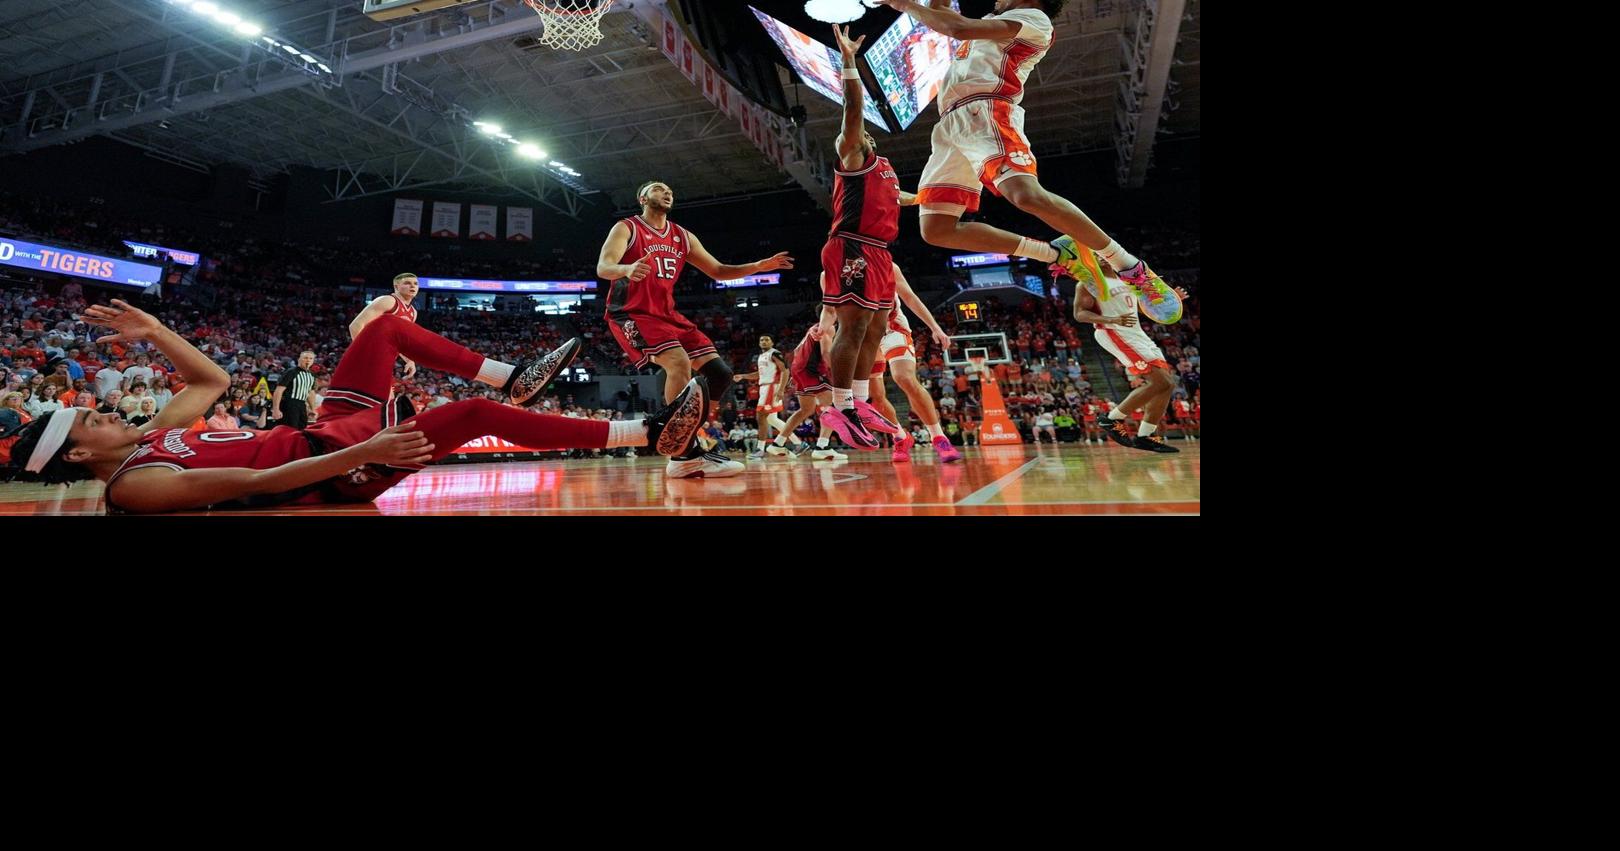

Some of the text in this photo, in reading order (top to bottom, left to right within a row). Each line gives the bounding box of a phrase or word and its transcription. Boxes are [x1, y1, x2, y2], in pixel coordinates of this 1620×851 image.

[644, 244, 683, 259] LOUISVILLE
[40, 249, 114, 278] TIGERS
[655, 256, 677, 279] 15
[1125, 295, 1134, 308] 0
[964, 309, 978, 320] 14
[199, 431, 254, 442] 0
